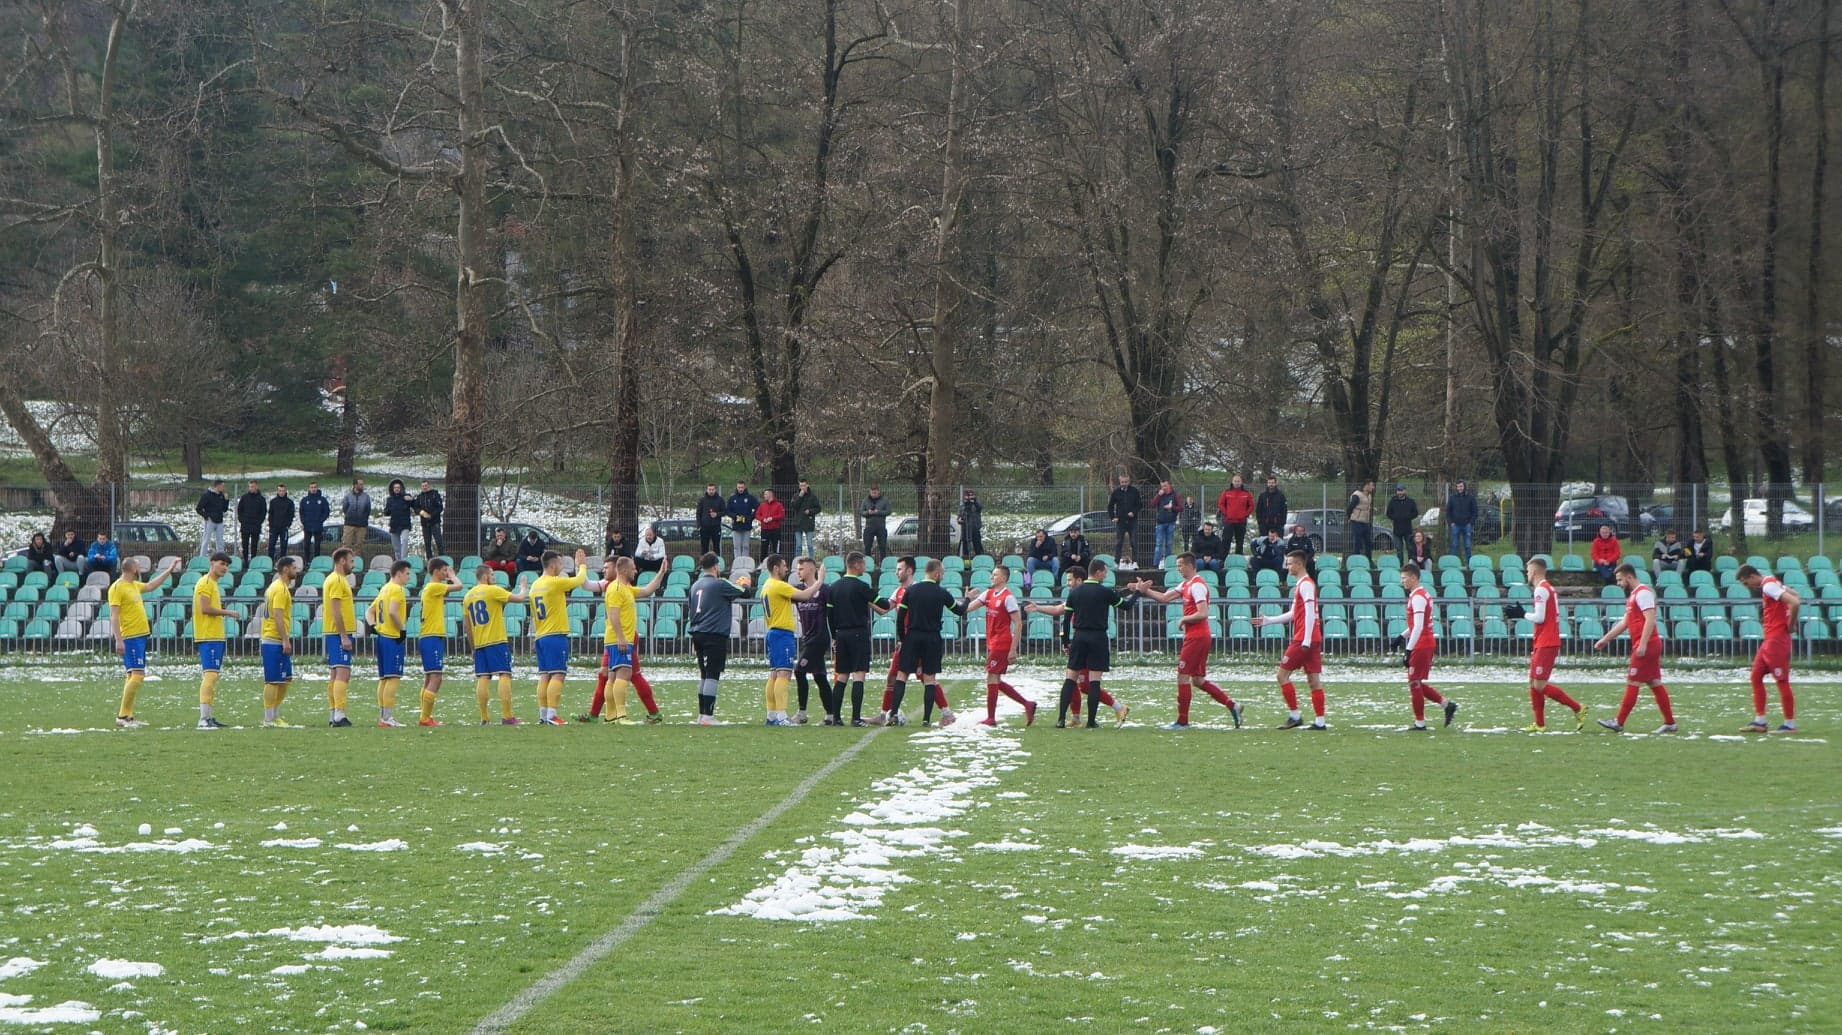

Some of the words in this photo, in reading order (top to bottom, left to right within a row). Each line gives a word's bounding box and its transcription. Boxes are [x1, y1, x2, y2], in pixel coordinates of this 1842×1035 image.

[467, 599, 490, 627] 18
[534, 596, 547, 620] 5
[695, 589, 703, 613] 1
